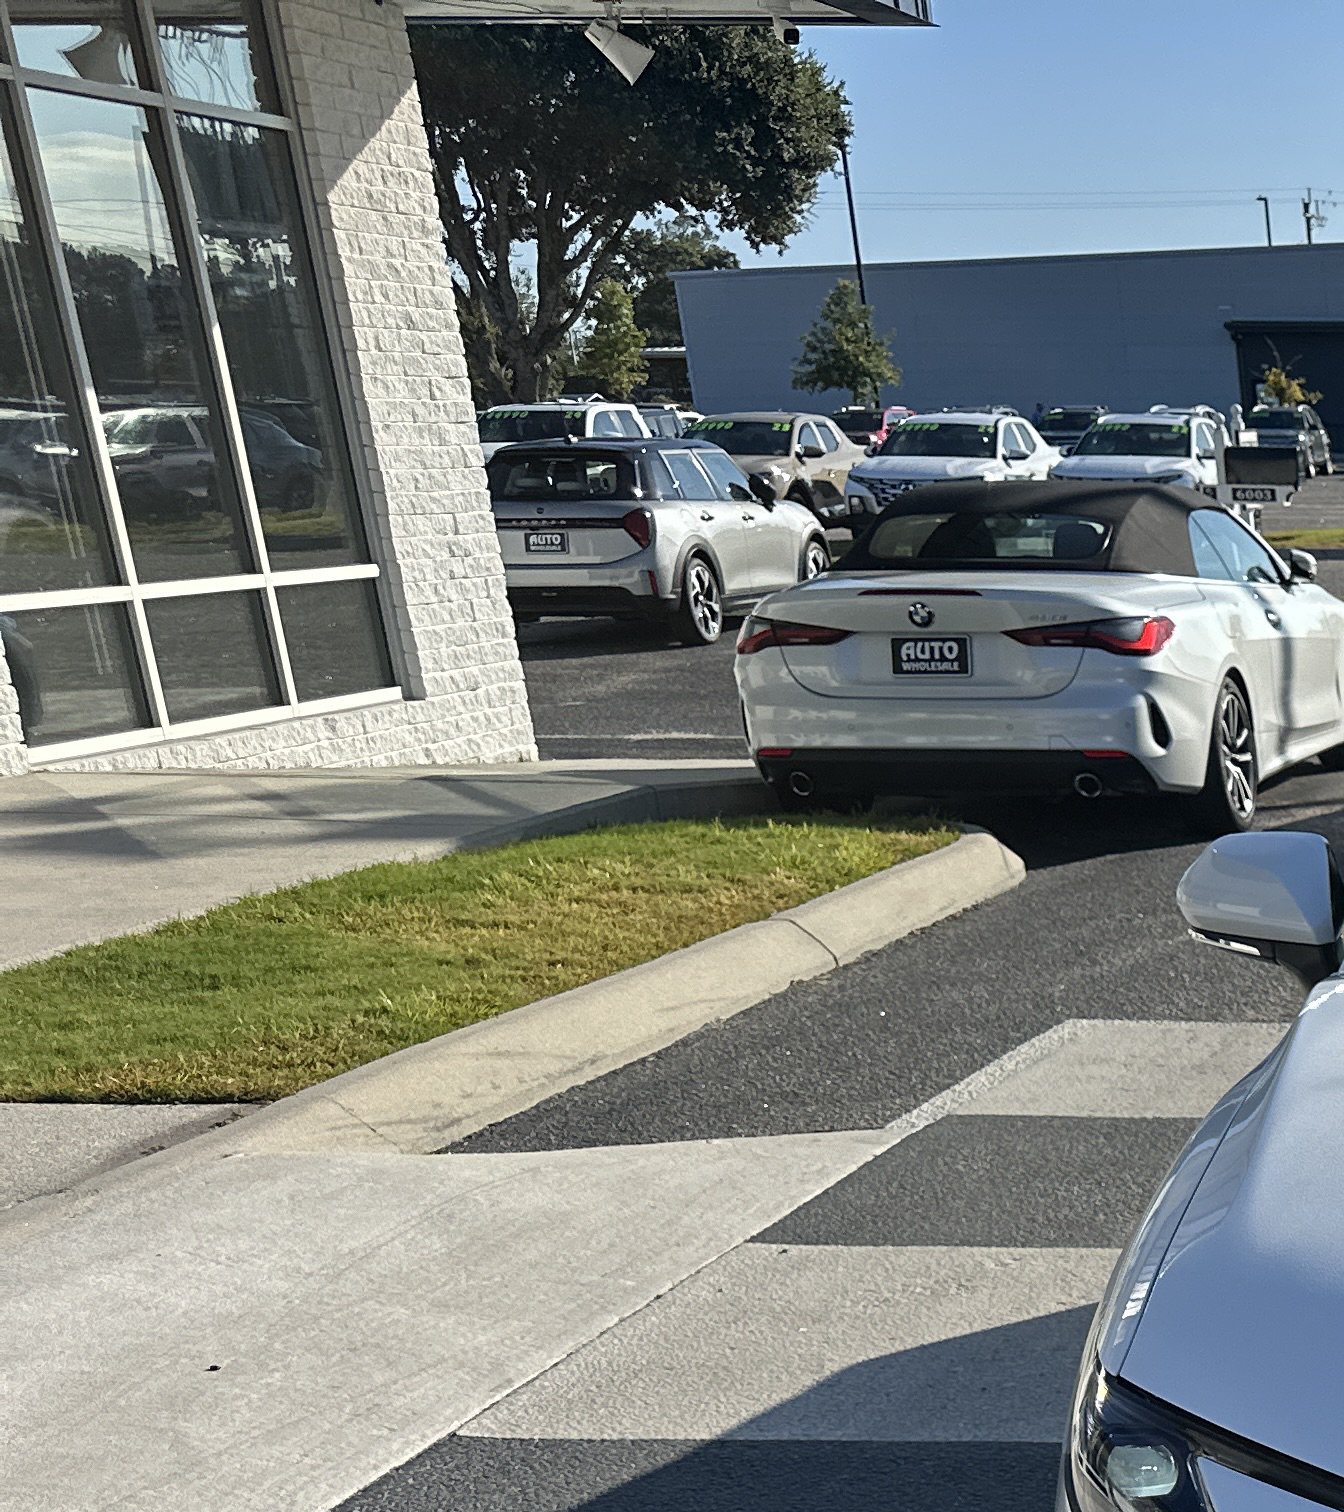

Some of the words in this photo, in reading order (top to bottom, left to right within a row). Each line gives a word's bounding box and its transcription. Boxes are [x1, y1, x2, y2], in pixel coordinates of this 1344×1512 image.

[1235, 489, 1272, 500] 6003
[529, 534, 561, 546] AUTO
[901, 641, 960, 661] AUTO
[901, 661, 960, 672] WHOLESALE
